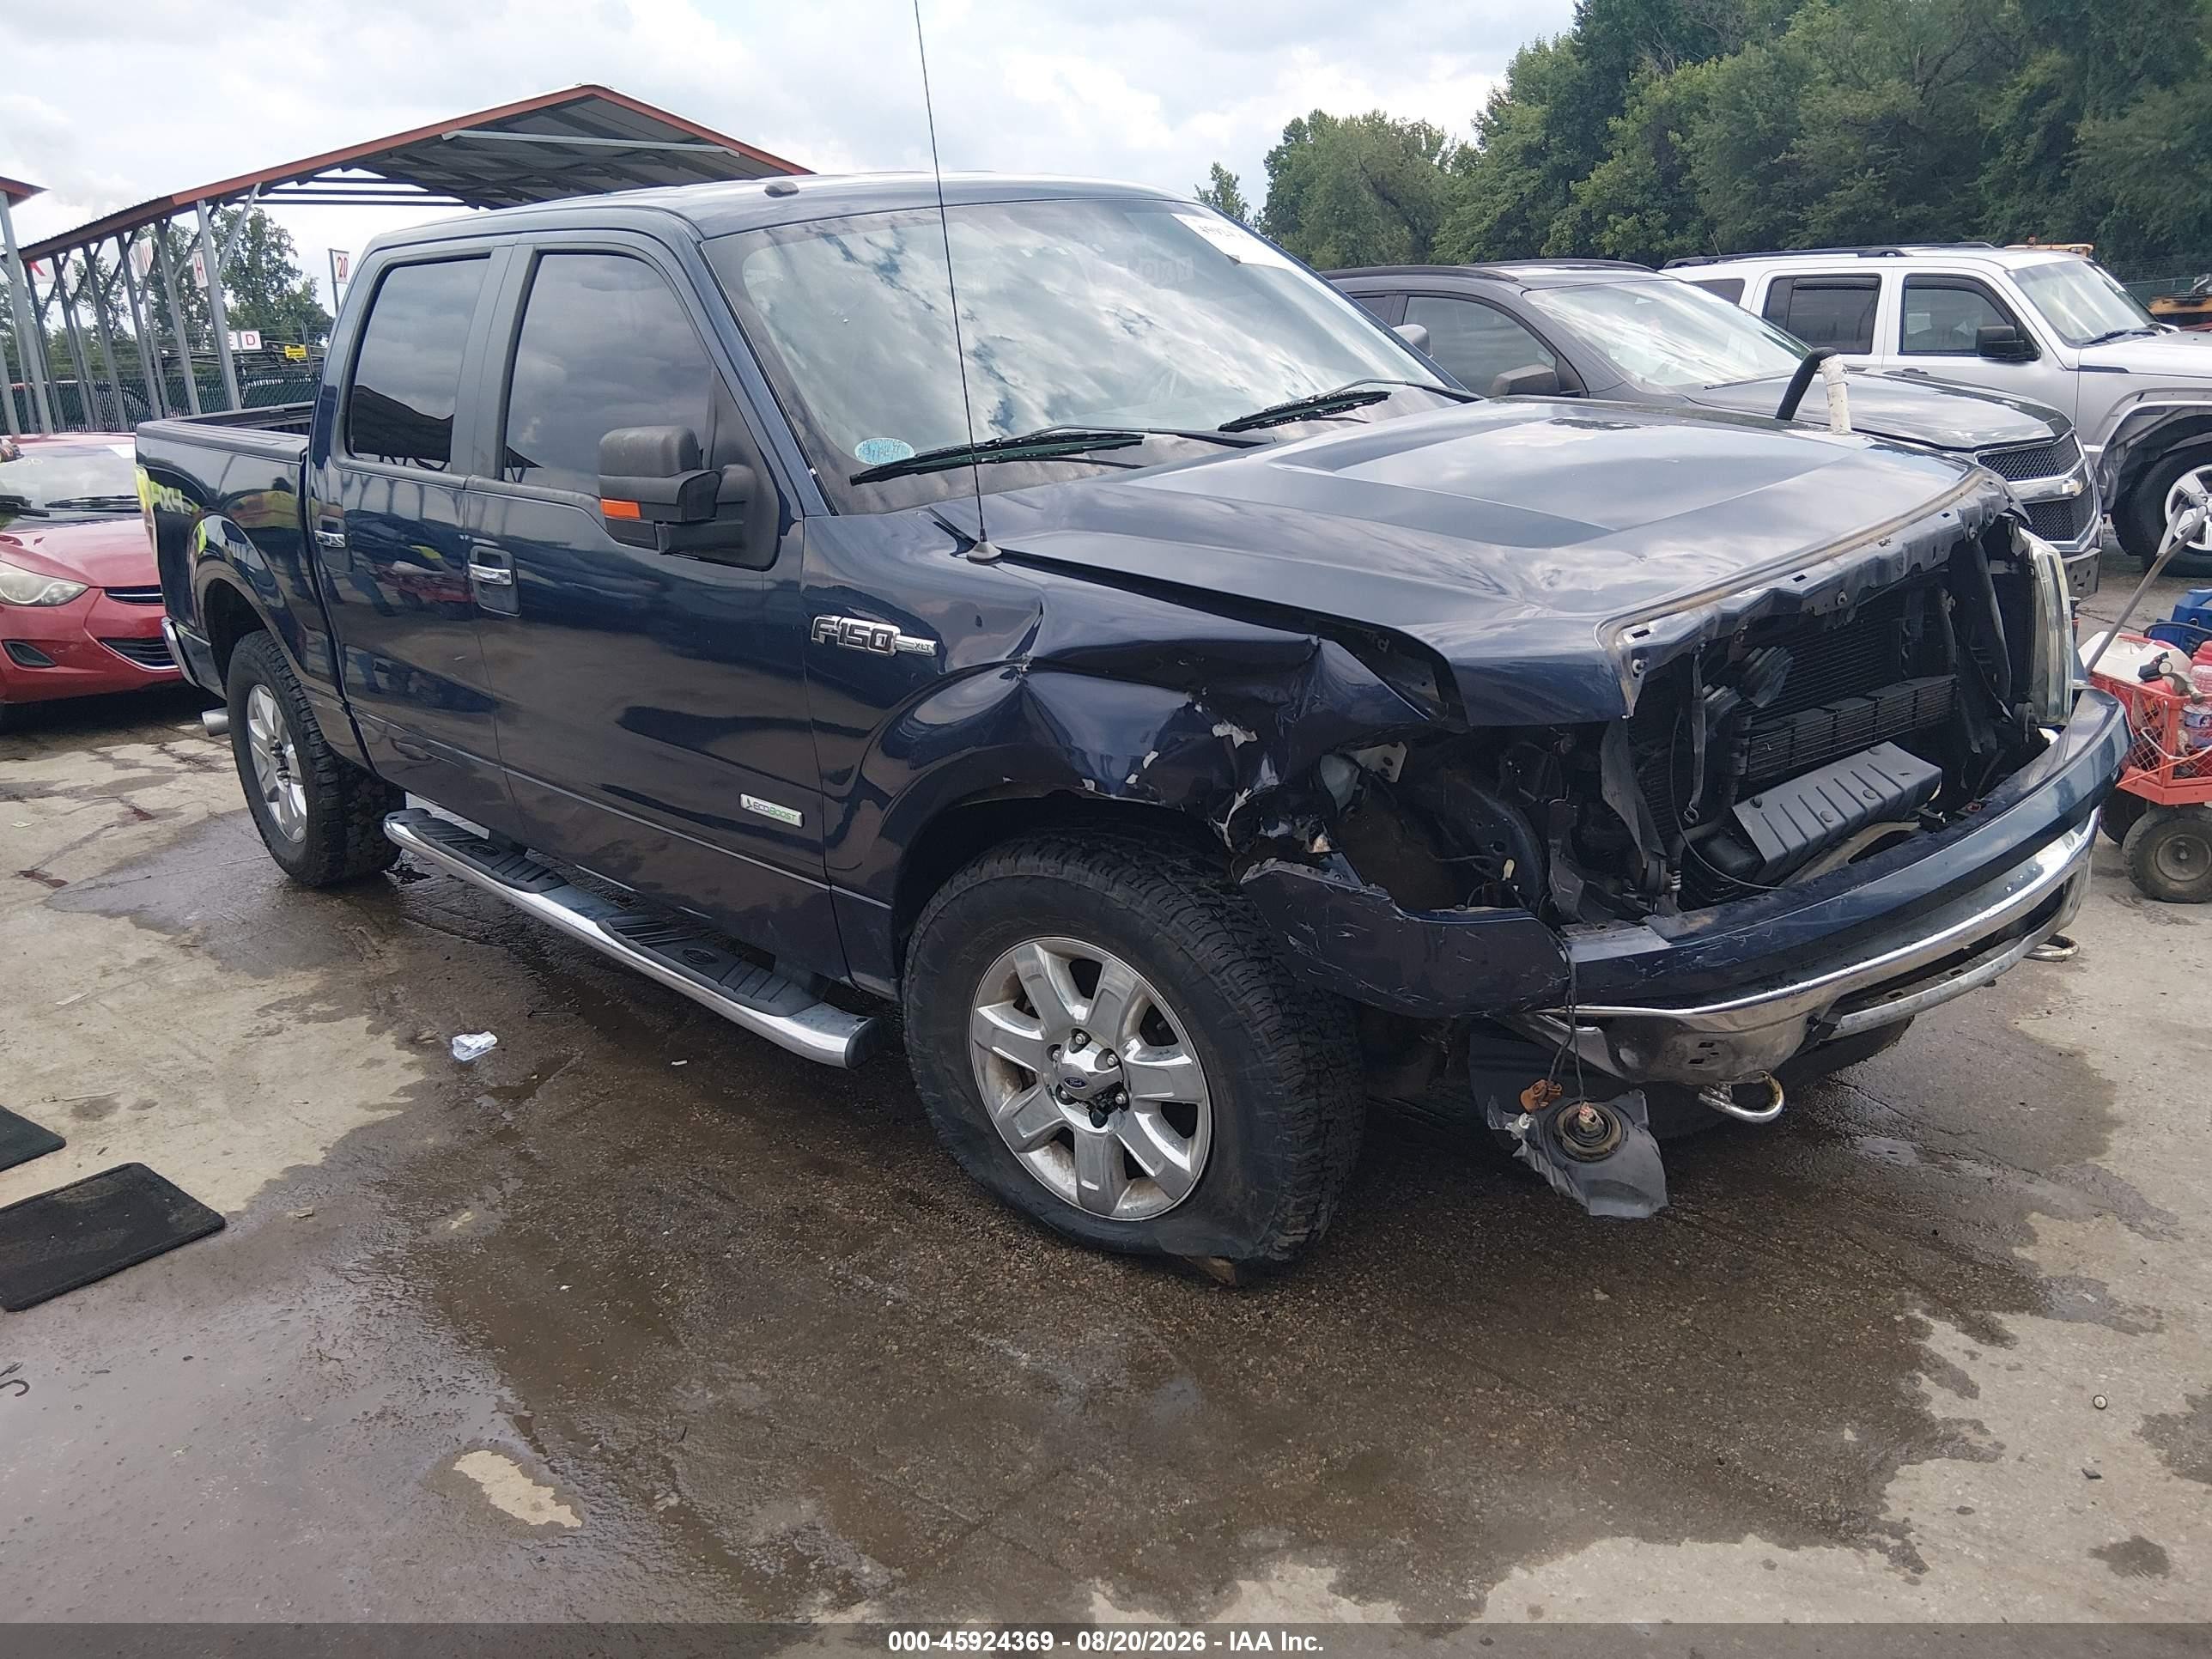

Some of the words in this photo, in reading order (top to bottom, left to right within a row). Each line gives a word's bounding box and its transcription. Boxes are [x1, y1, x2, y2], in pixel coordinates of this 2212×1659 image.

[194, 256, 204, 281] H
[337, 256, 349, 278] 20
[245, 333, 256, 345] D
[914, 641, 931, 652] XLT
